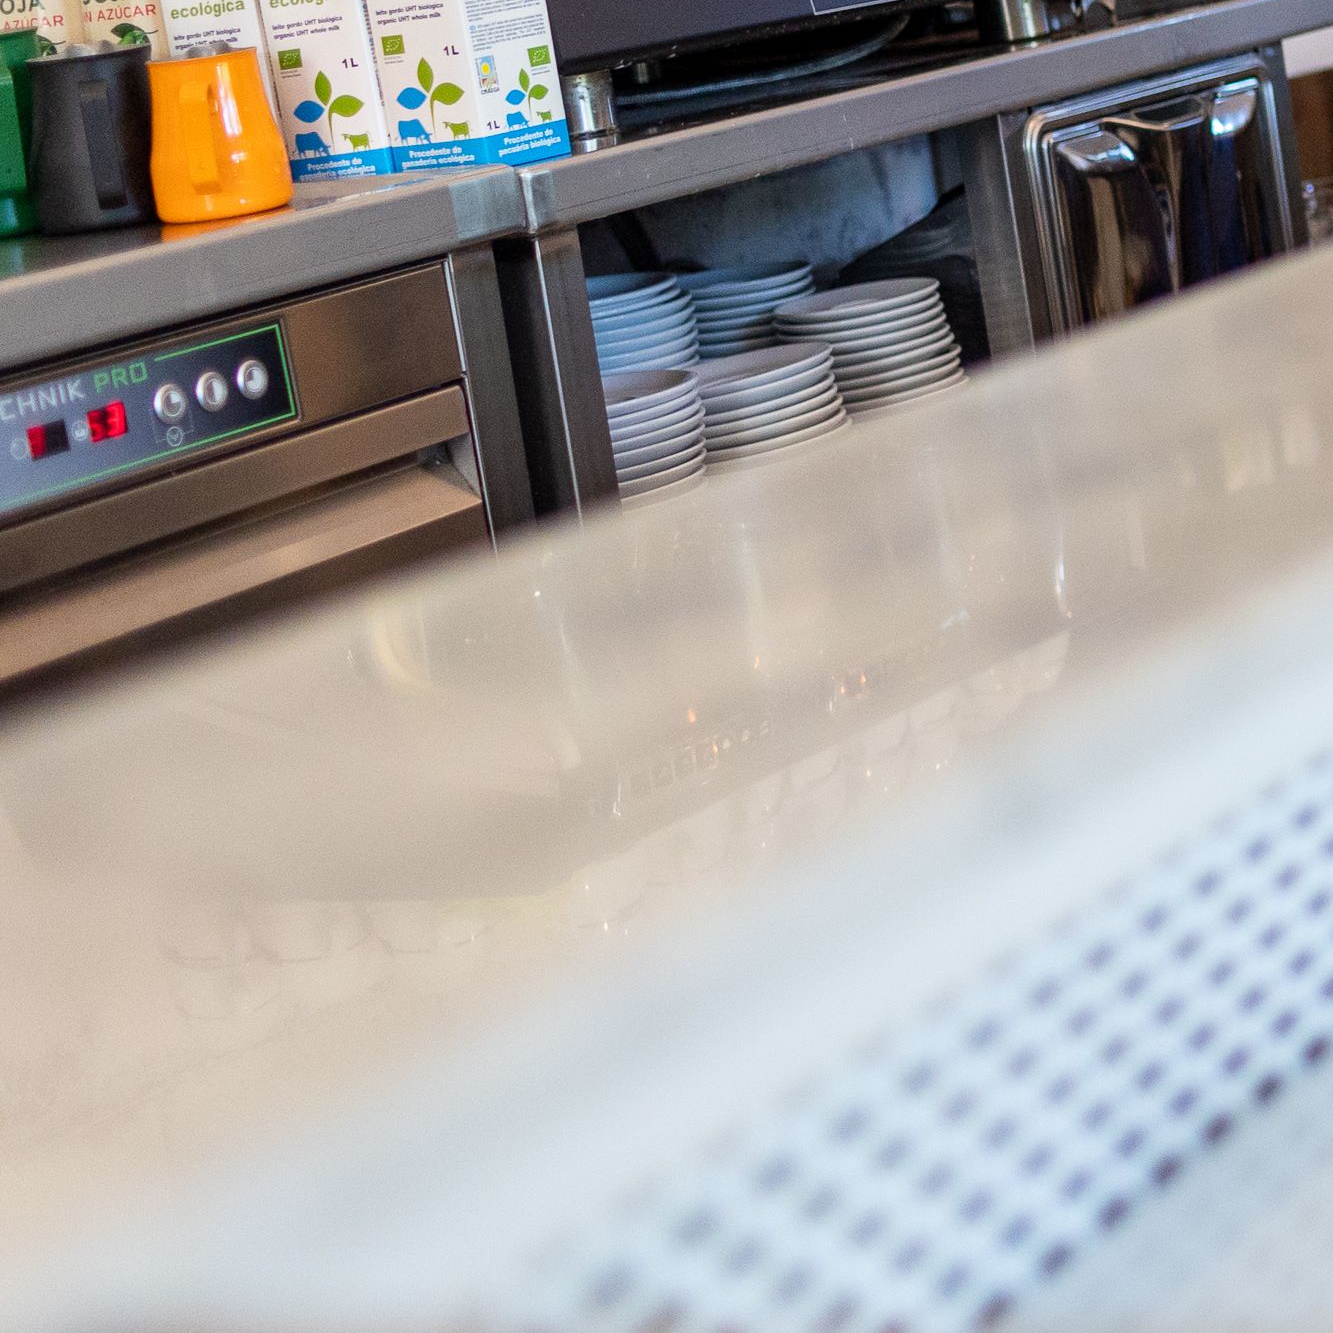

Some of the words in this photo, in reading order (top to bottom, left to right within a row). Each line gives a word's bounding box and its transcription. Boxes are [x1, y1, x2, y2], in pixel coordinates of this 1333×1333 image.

[97, 4, 156, 22] AZÚCAR
[170, 0, 245, 20] ecológica
[94, 361, 149, 394] PRO
